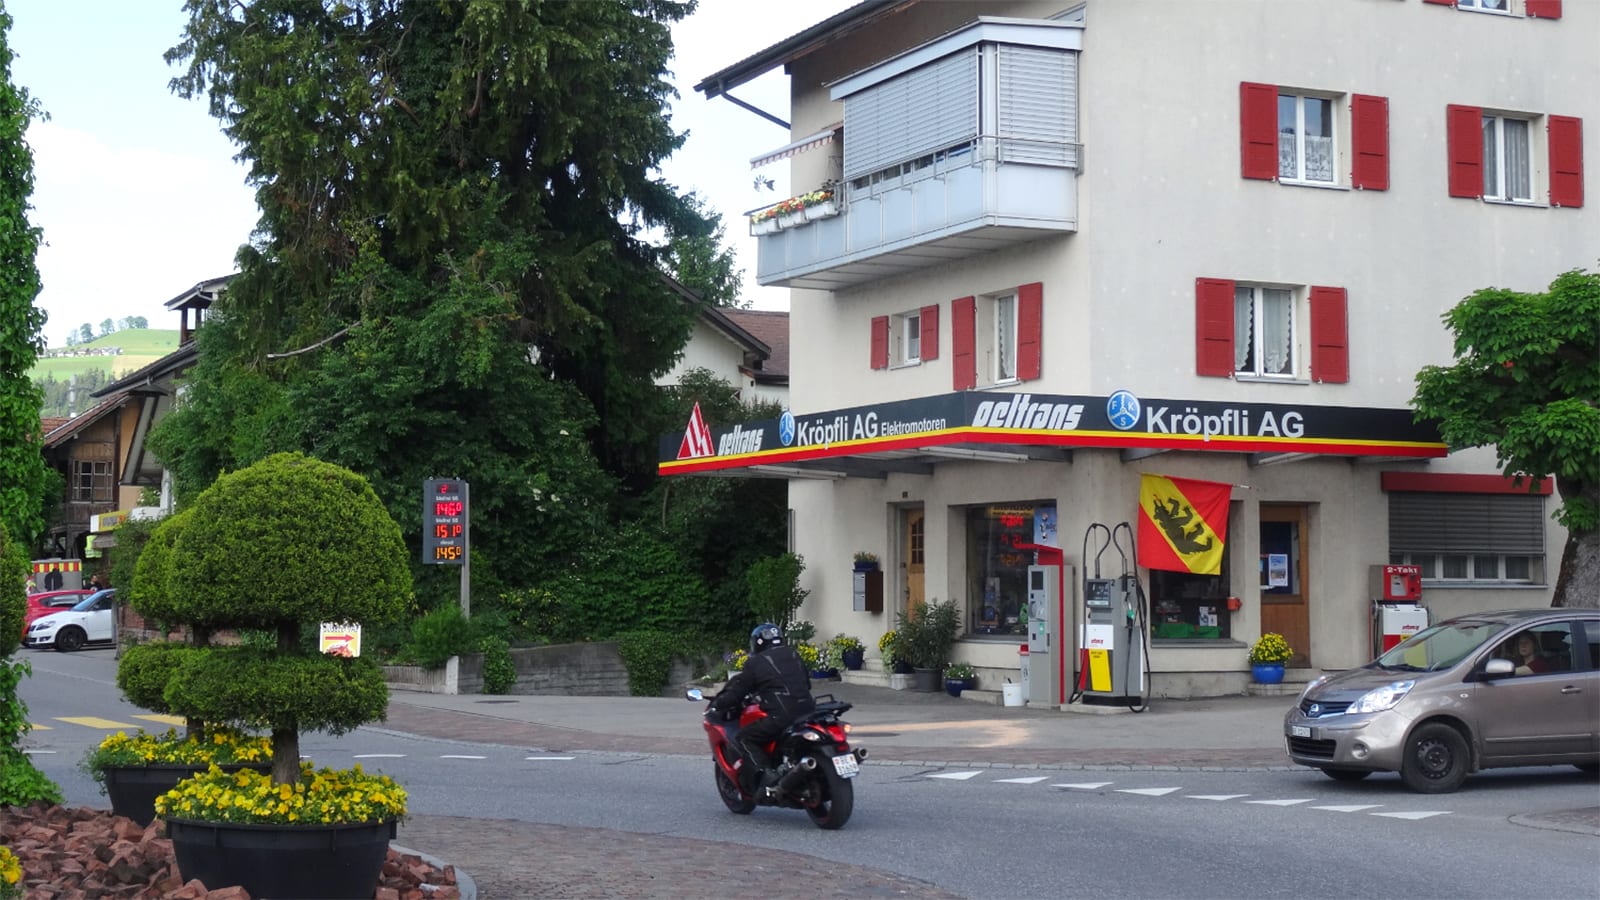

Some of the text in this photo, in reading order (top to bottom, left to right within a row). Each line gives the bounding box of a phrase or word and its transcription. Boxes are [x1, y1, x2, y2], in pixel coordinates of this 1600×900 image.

[971, 394, 1084, 430] oeltrans
[1146, 406, 1305, 442] Kröpfli AG
[797, 415, 849, 450] Kröpfli
[852, 411, 878, 440] AG
[881, 417, 946, 436] Elektromotoren
[1387, 566, 1418, 574] 2-Takt
